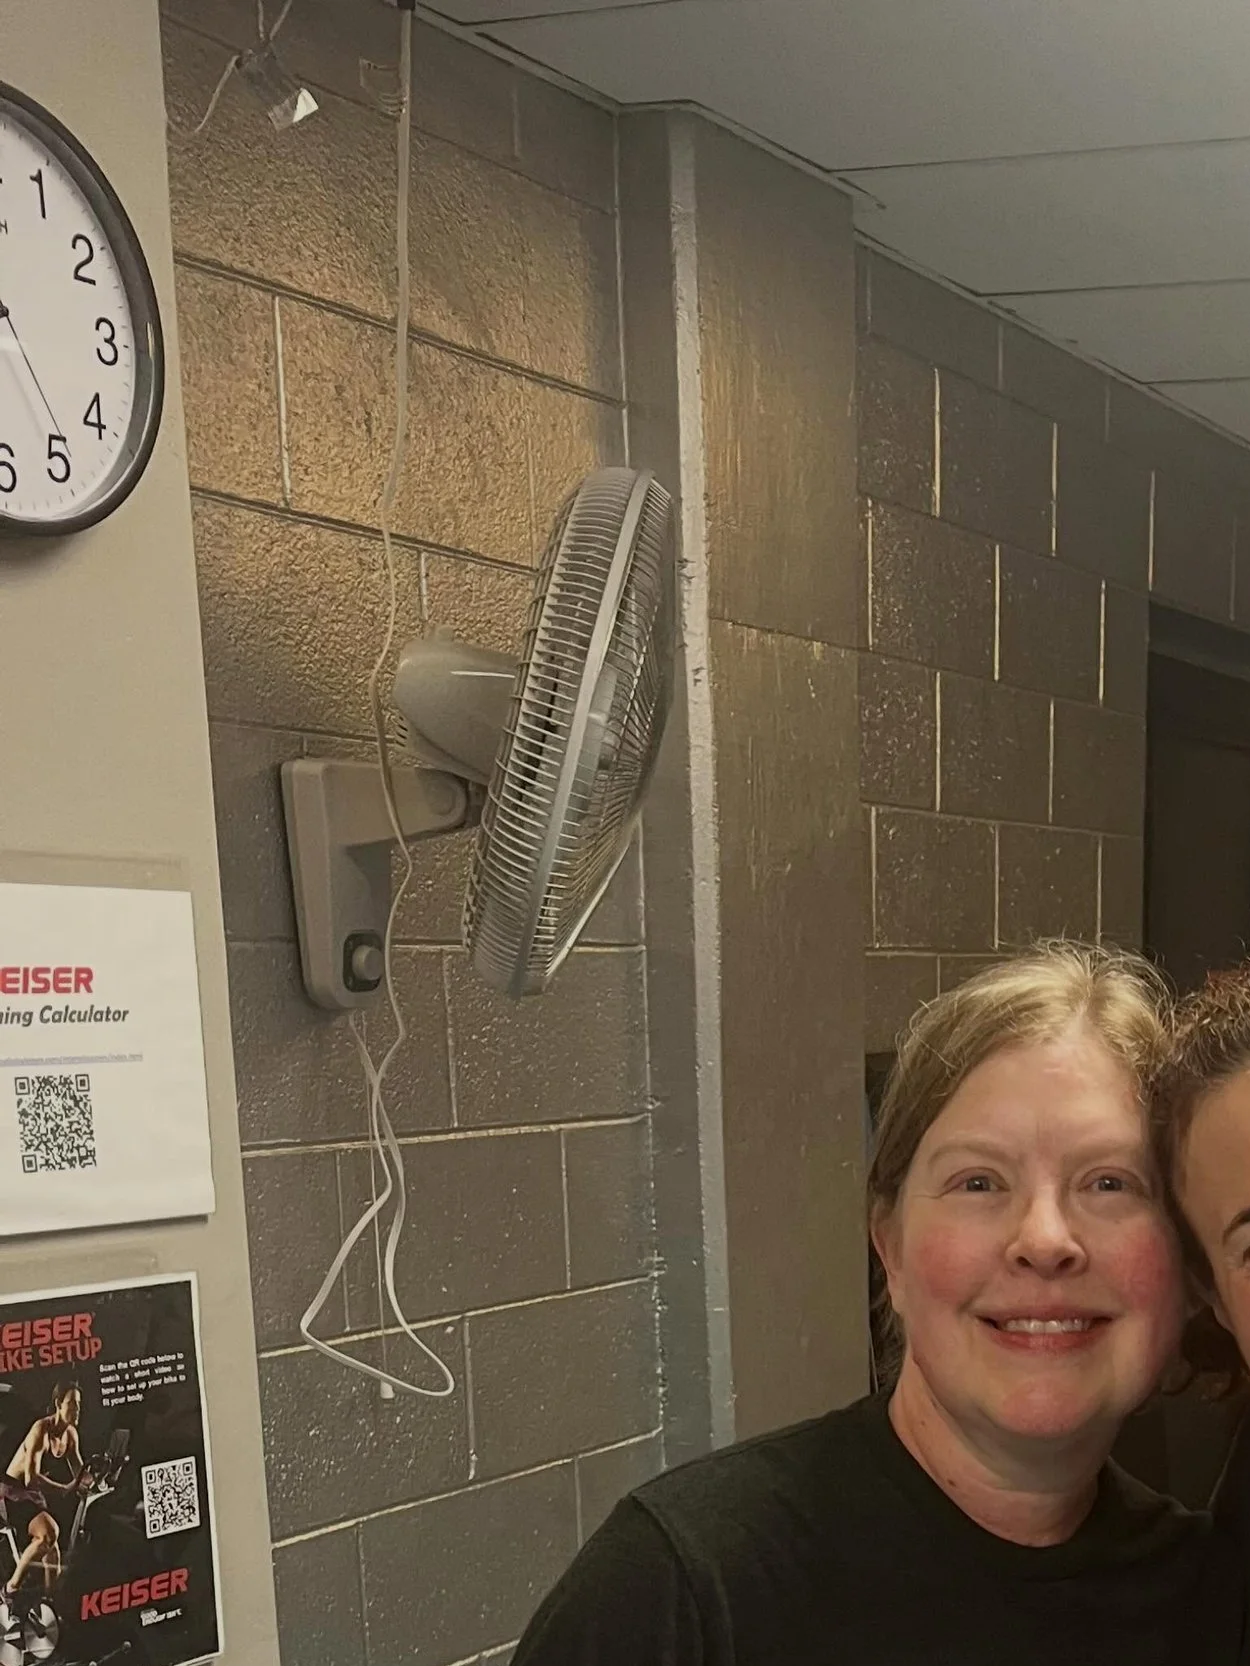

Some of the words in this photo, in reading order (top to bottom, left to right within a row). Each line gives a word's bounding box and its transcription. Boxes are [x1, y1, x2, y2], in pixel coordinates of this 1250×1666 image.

[29, 168, 46, 219] 1
[71, 233, 96, 285] 2
[95, 317, 118, 366] 3
[83, 392, 107, 440] 4
[46, 433, 71, 483] 5
[40, 1004, 130, 1024] Calculator
[0, 1312, 93, 1349] EISER
[39, 1336, 103, 1367] SETUP
[81, 1567, 190, 1621] KEISER
